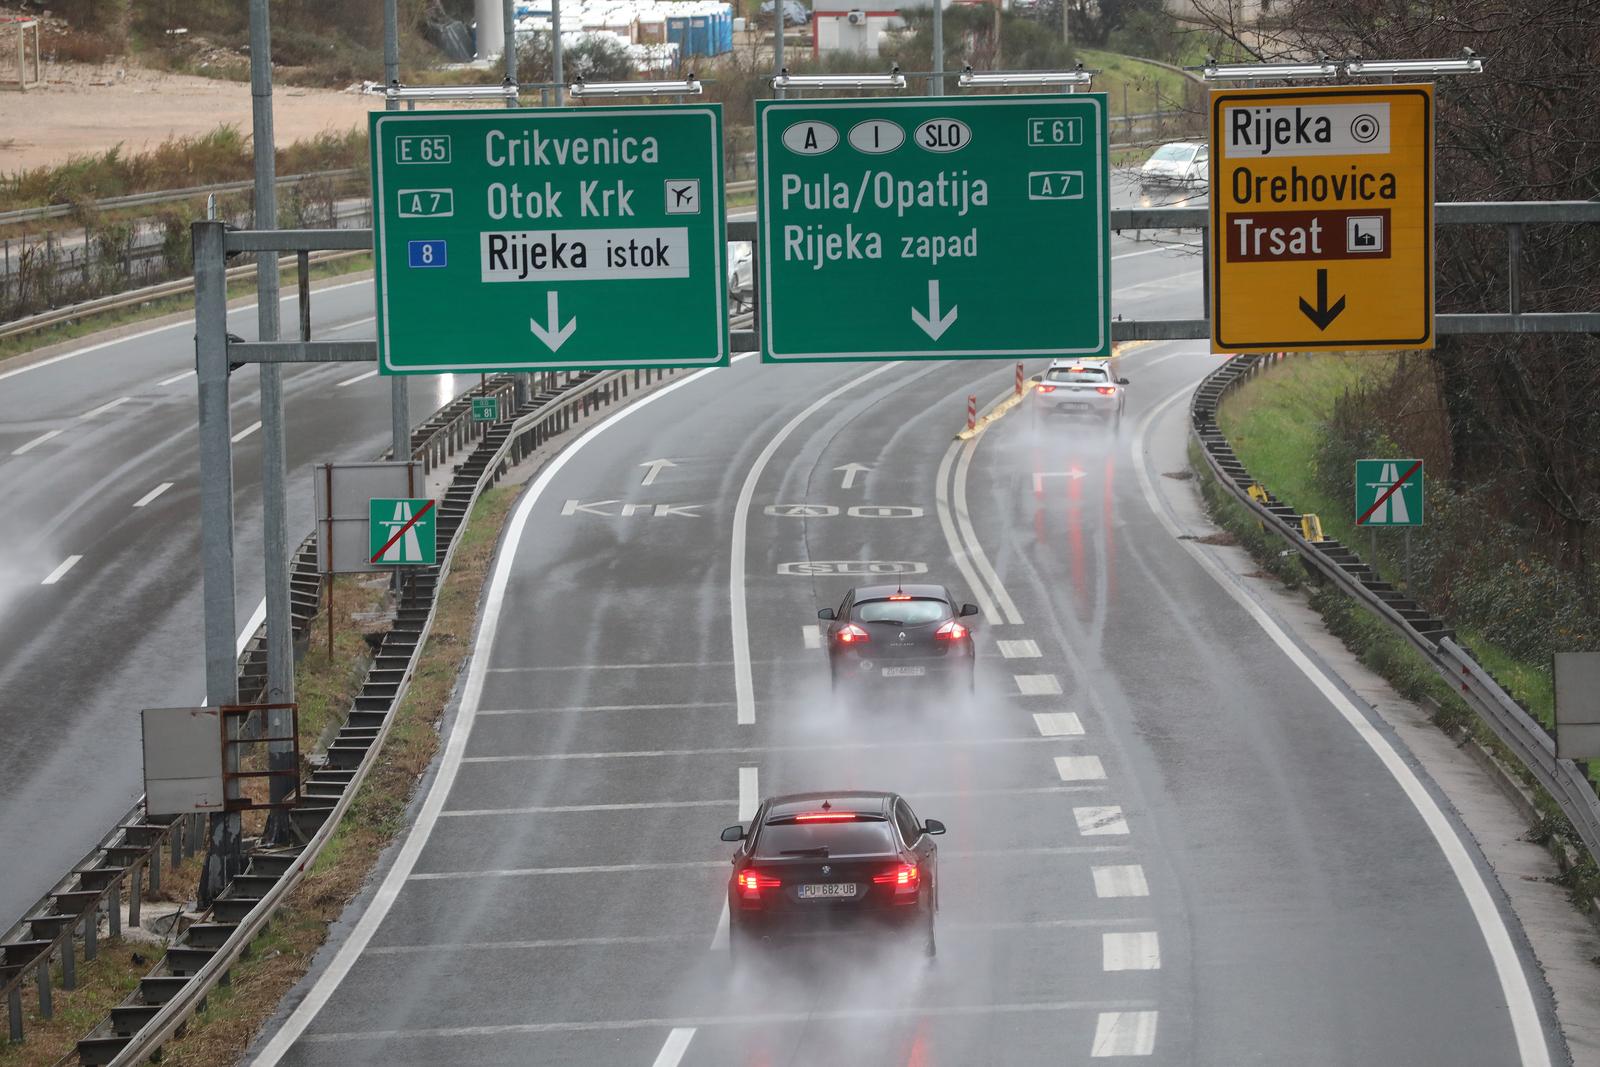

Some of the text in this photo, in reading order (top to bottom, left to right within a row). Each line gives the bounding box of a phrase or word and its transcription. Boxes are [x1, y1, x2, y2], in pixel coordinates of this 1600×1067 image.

[803, 127, 818, 149] A
[873, 125, 880, 148] I
[925, 123, 960, 147] SLO
[1033, 120, 1074, 143] E 61
[1232, 107, 1331, 155] Rijeka
[401, 139, 447, 161] E 65
[485, 128, 659, 168] Crikvenica
[782, 170, 989, 218] Pula/Opatija
[1042, 176, 1071, 195] A 7
[1232, 165, 1397, 205] Orehovica
[411, 193, 441, 213] A 7
[487, 179, 635, 220] Otok Krk
[784, 223, 977, 270] Rijeka zapad
[1234, 217, 1323, 256] Trsat
[421, 244, 433, 264] 8
[488, 233, 670, 280] Rijeka istok
[797, 563, 904, 573] SLO
[804, 885, 816, 896] PU
